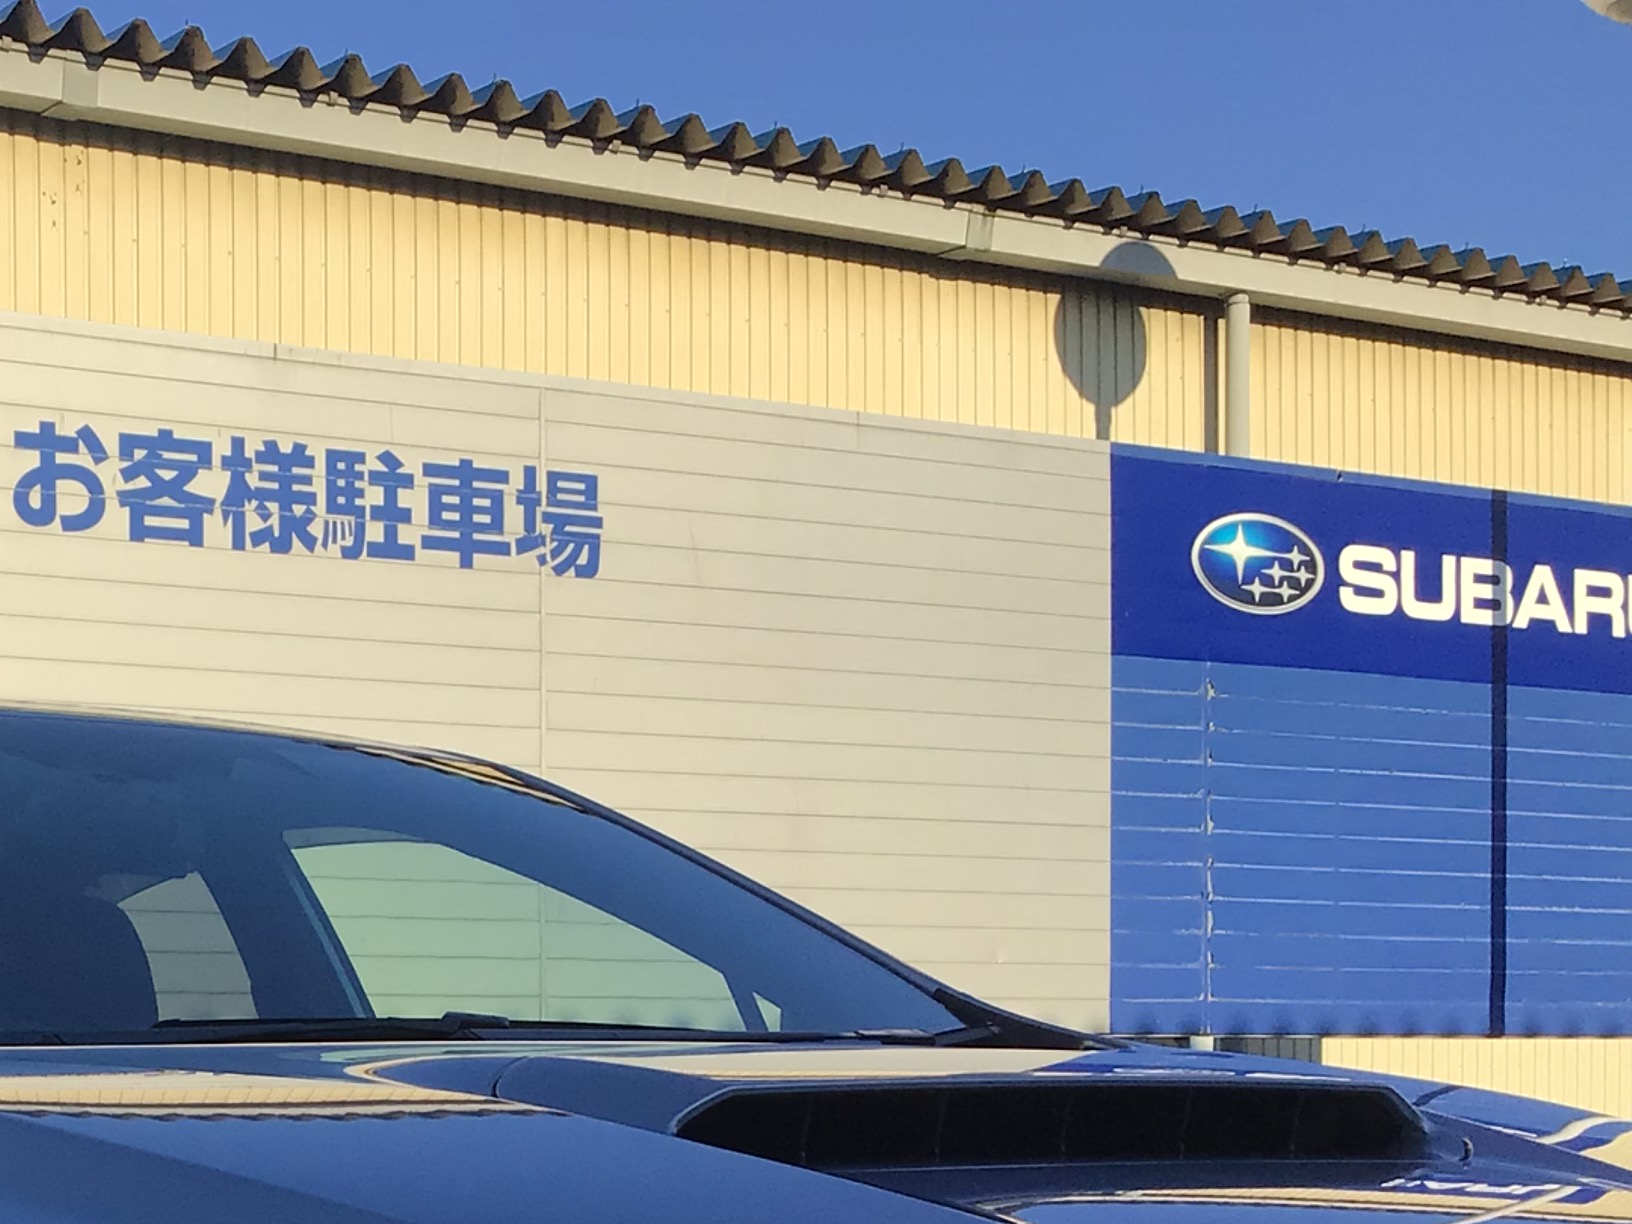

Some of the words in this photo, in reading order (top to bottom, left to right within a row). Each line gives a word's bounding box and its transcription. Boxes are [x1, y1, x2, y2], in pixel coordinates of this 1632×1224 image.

[12, 420, 604, 579] お客様駐車場
[1338, 544, 1632, 638] SUBAR
